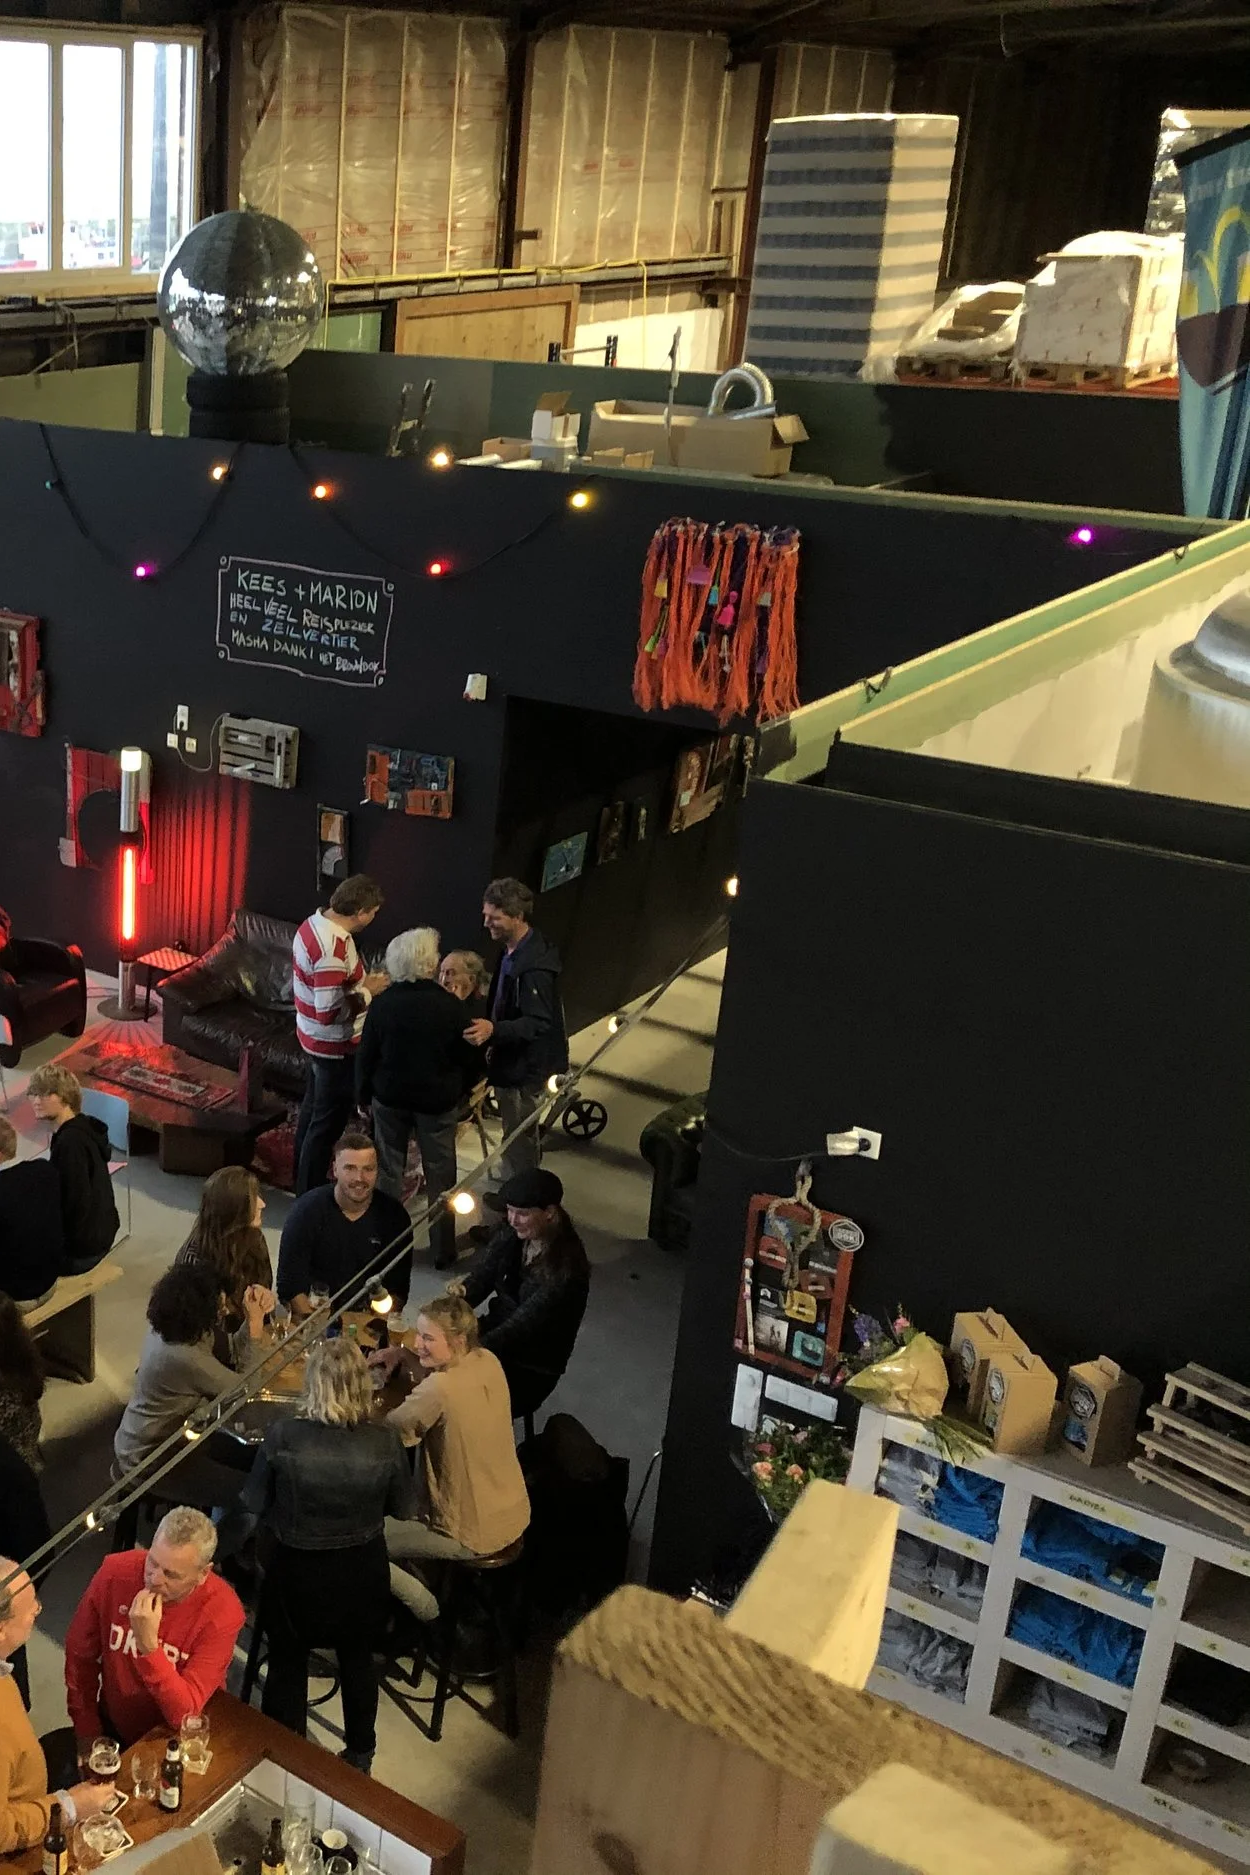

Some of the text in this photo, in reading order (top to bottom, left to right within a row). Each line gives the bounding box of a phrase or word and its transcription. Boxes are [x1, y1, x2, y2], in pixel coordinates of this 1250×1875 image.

[238, 568, 286, 596] KEES
[310, 581, 378, 614] MARION
[230, 593, 374, 635] HEEL VEEL REISPLEZIER
[230, 611, 360, 651] EN ZEILVERTIER
[231, 629, 269, 651] MASHA
